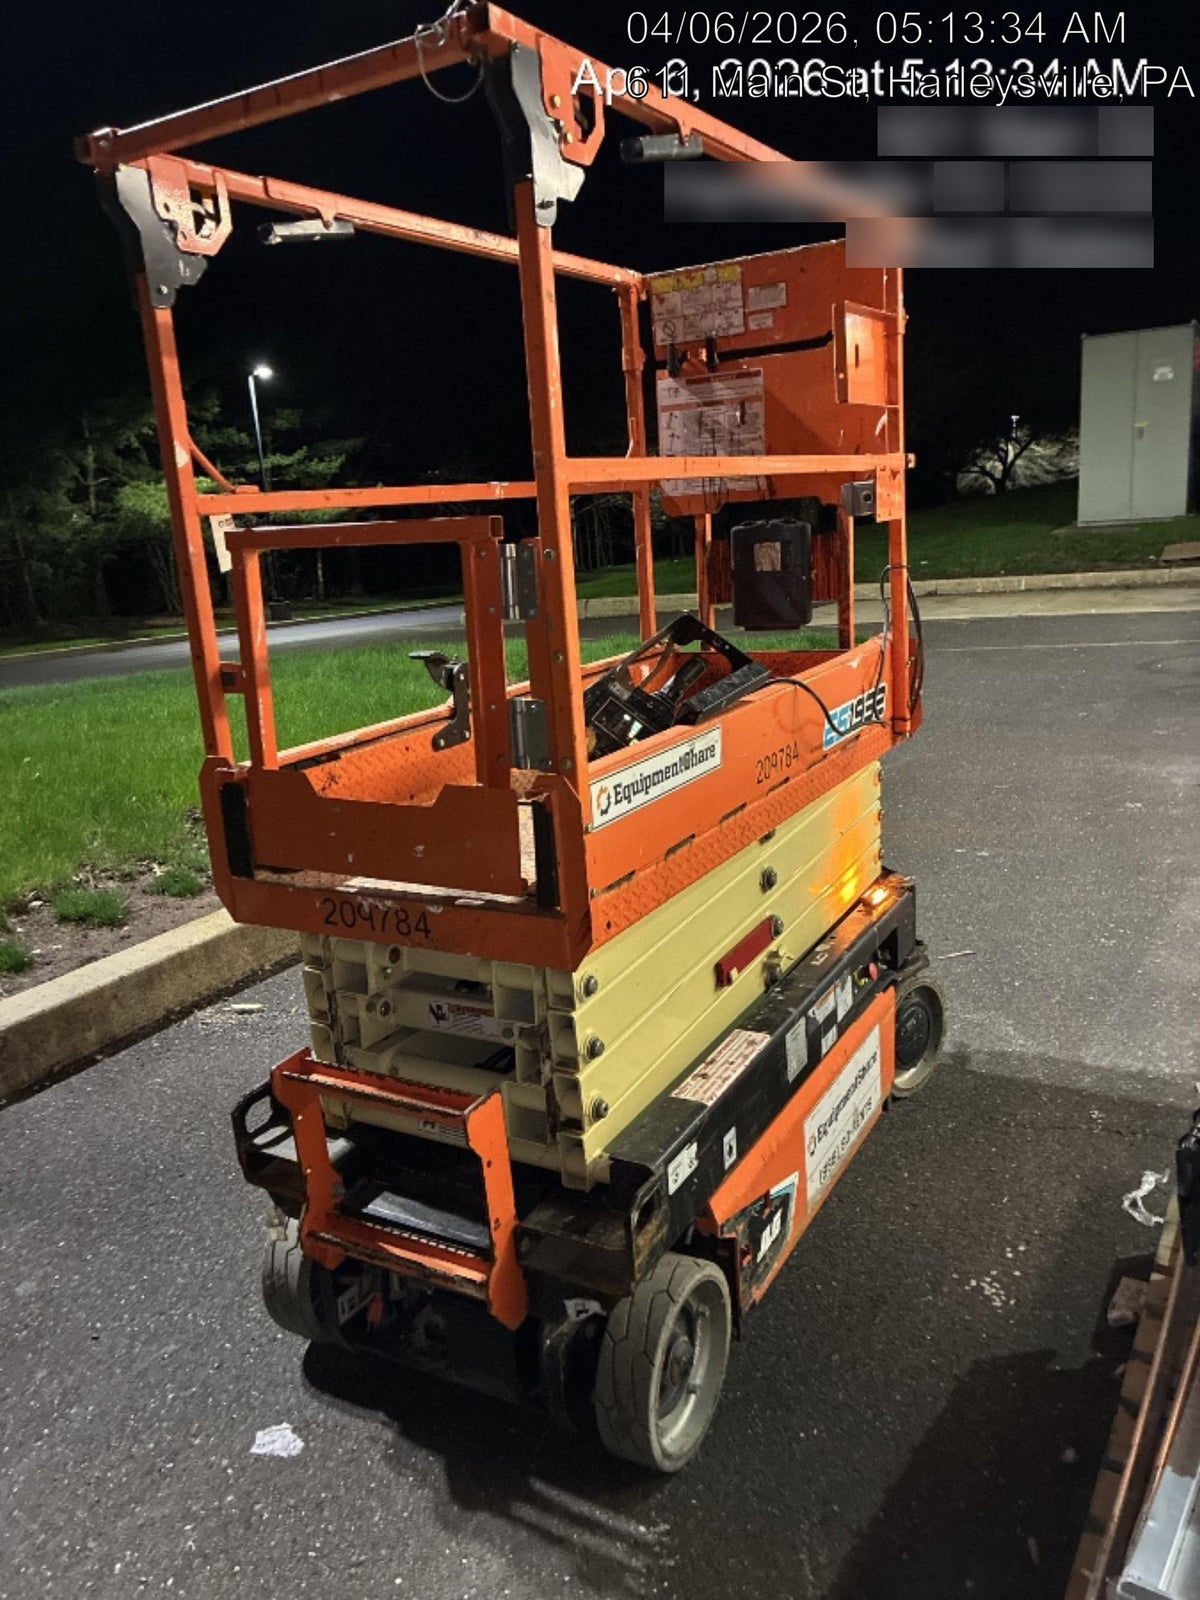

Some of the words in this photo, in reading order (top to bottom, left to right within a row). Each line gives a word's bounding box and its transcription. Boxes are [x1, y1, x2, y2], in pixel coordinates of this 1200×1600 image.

[613, 744, 716, 805] EquipmentShare
[757, 741, 799, 784] 209784
[322, 898, 431, 939] 209784
